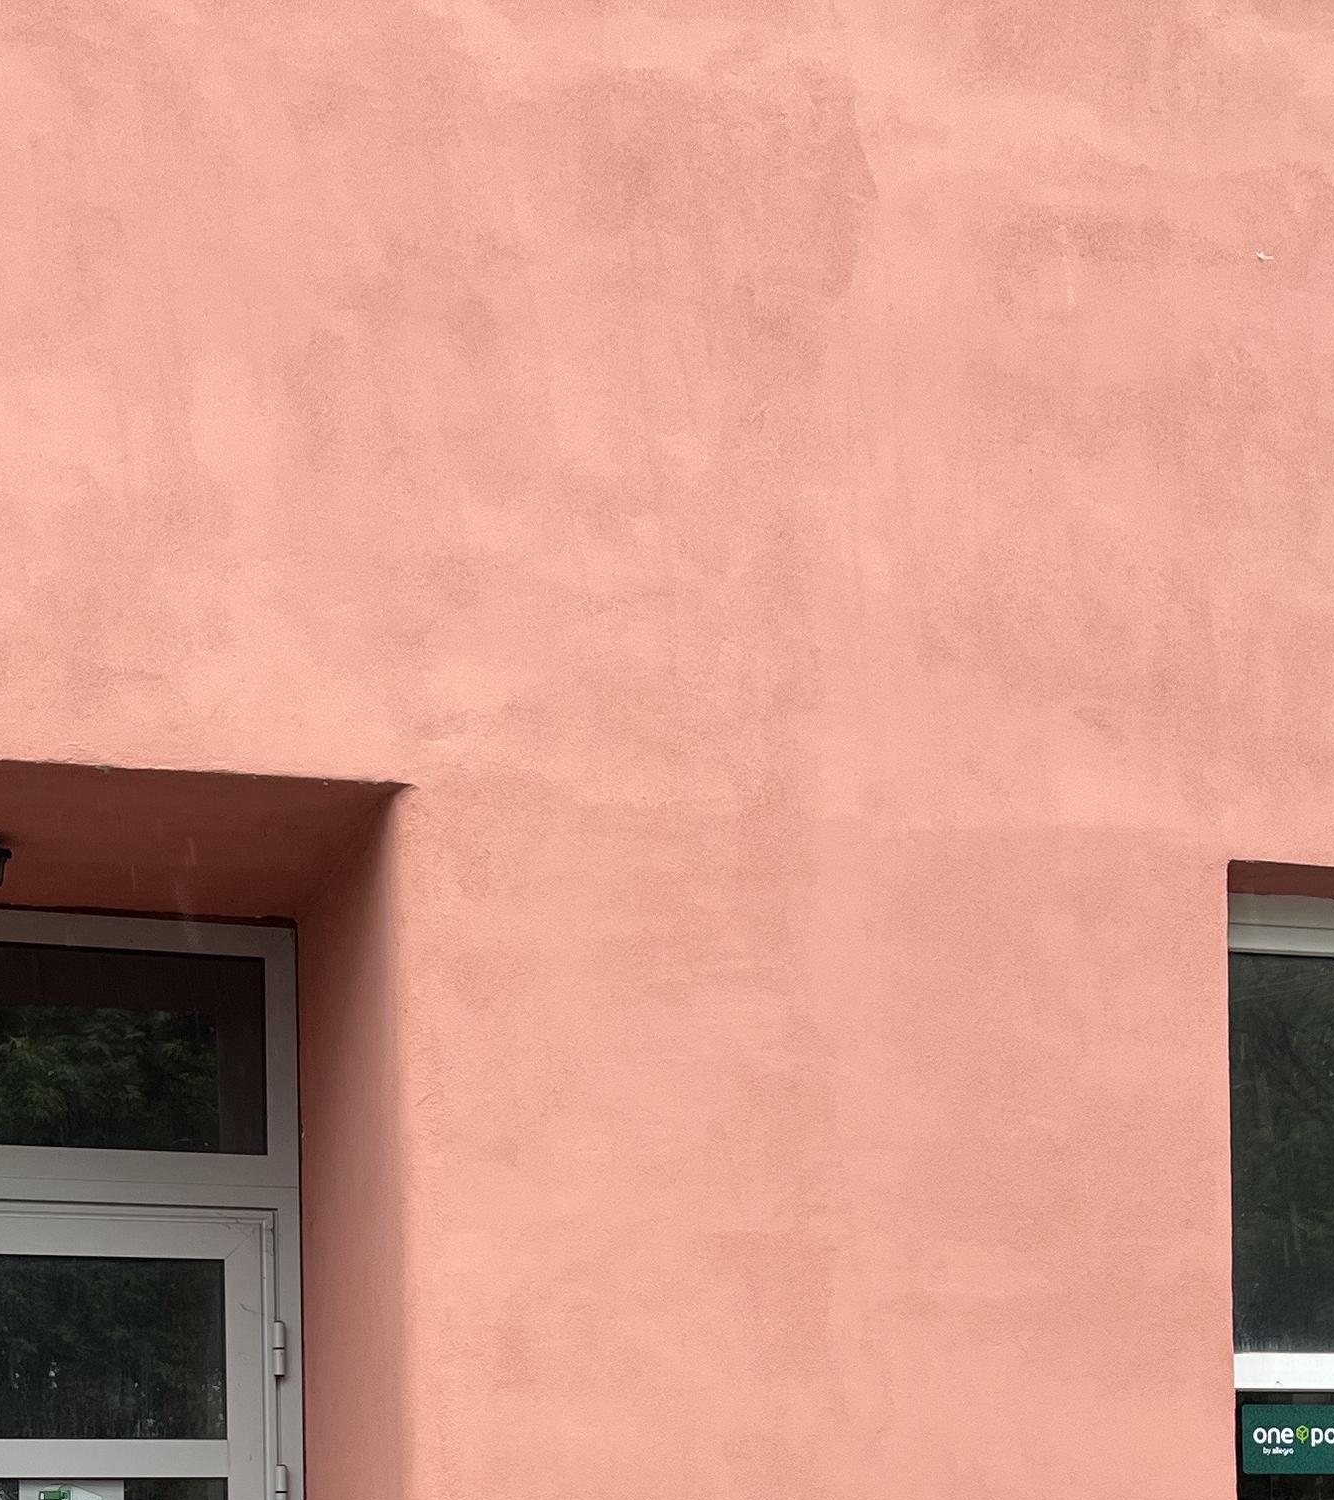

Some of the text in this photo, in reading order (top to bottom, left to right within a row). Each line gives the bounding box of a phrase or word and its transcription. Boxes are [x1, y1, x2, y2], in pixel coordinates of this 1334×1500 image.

[1252, 1427, 1295, 1444] one
[1262, 1446, 1294, 1457] by allegro
